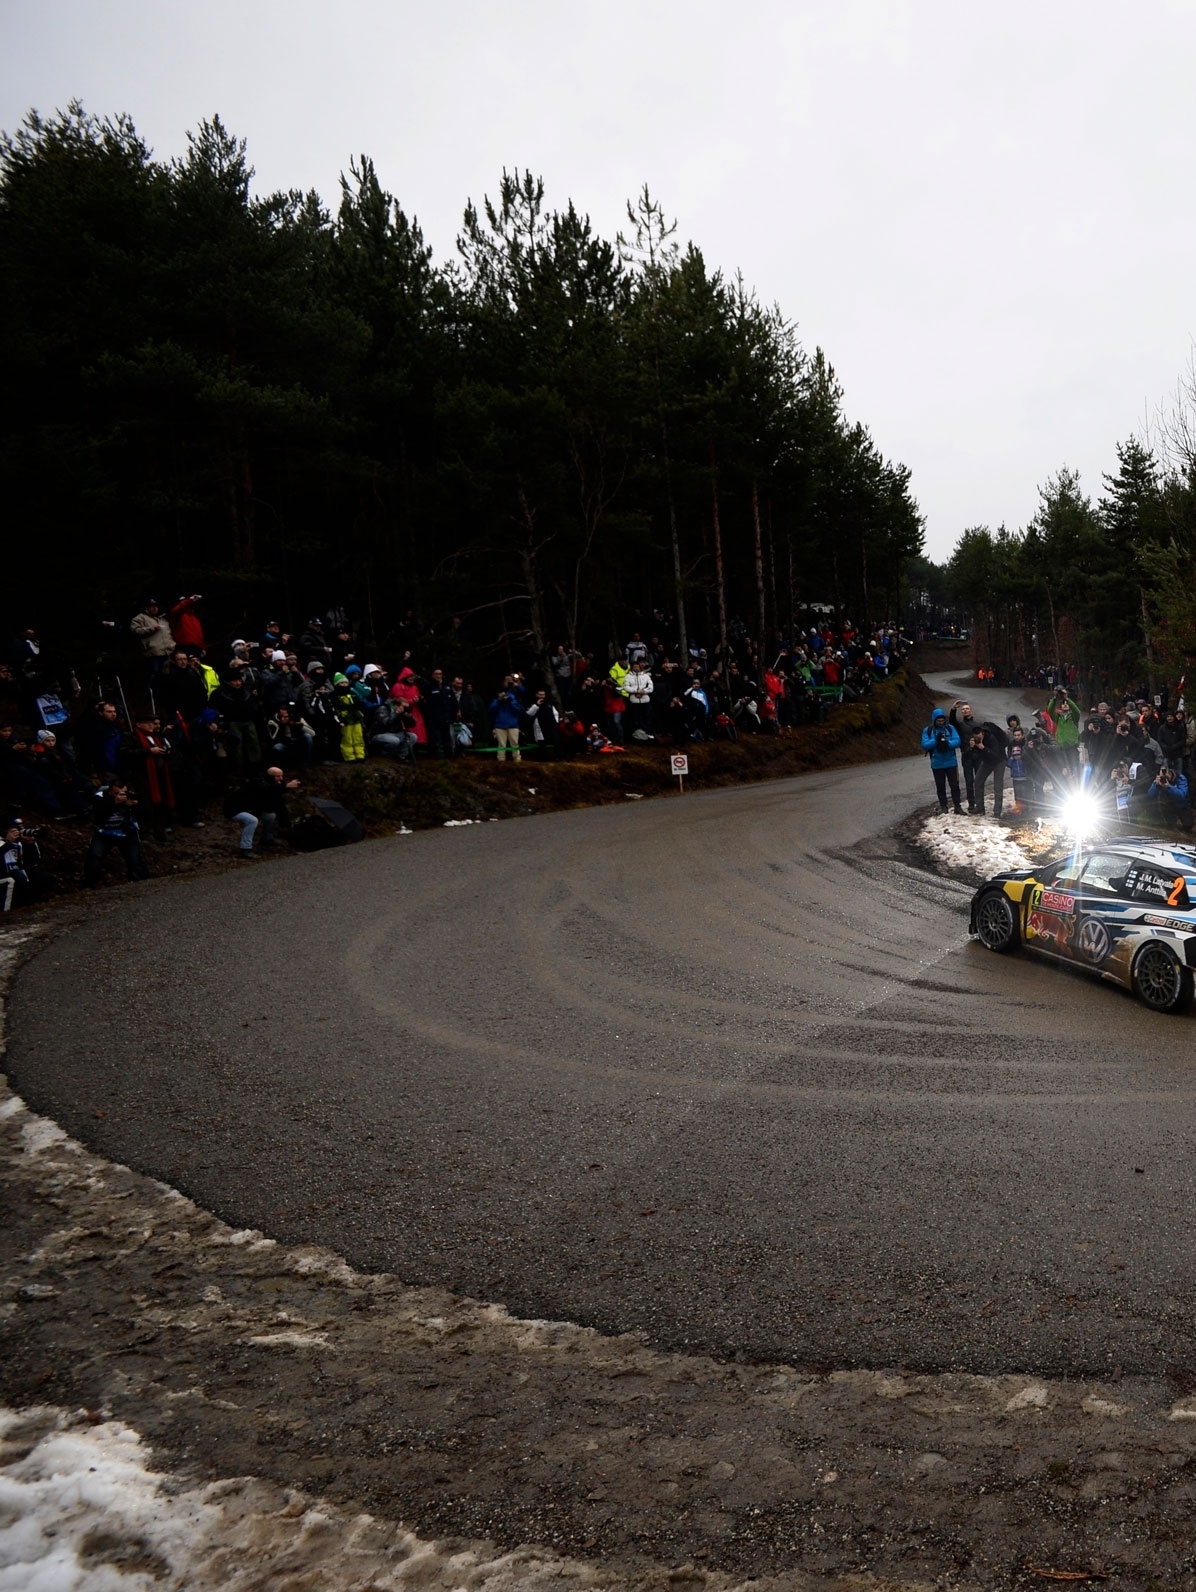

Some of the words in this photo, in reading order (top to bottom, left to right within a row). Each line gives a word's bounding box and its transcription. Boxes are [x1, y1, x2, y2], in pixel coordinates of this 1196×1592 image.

[1136, 882, 1145, 891] M.
[1167, 876, 1185, 906] 2
[1034, 890, 1041, 905] 2
[1043, 892, 1073, 907] CASINO
[1166, 919, 1195, 932] EDGE
